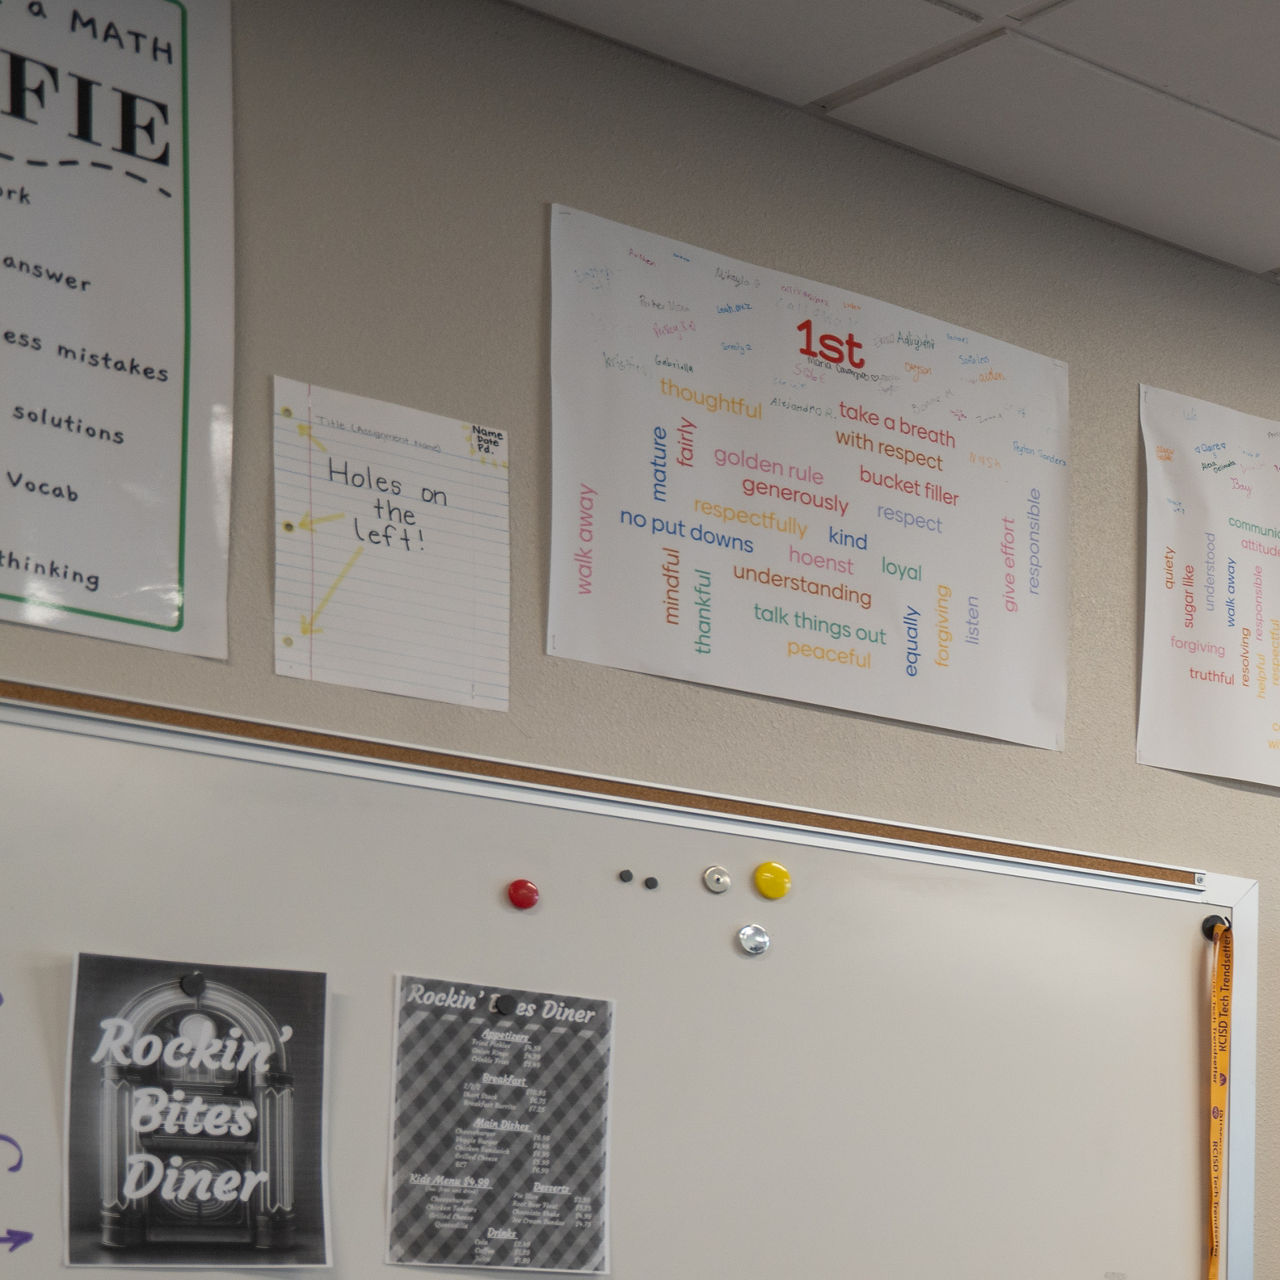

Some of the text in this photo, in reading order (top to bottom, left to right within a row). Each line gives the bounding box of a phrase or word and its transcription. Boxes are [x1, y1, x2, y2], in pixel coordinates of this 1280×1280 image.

[28, 1, 173, 65] a MATH
[3, 255, 91, 292] answer
[57, 344, 169, 383] mistakes
[797, 320, 865, 369] 1st
[660, 378, 763, 421] thoughtful
[12, 404, 125, 444] solutions
[472, 424, 505, 441] Name
[838, 401, 956, 448] take a breath
[6, 471, 79, 502] Vocab
[329, 456, 448, 507] Holes on
[742, 477, 848, 517] generously
[860, 465, 959, 506] bucket filler
[373, 497, 417, 526] the
[693, 499, 807, 540] respectfully
[354, 517, 425, 551] left!
[788, 546, 855, 576] hoenst
[662, 548, 680, 625] mindful
[733, 562, 872, 610] understanding
[694, 570, 712, 655] thankful
[753, 604, 887, 645] talk things out
[934, 584, 952, 668] forgiving
[787, 639, 872, 670] peaceful
[1171, 636, 1225, 657] forgiving
[1189, 667, 1235, 686] truthful
[542, 1000, 596, 1024] Diner
[131, 1087, 259, 1136] Bites
[122, 1153, 270, 1204] Diner
